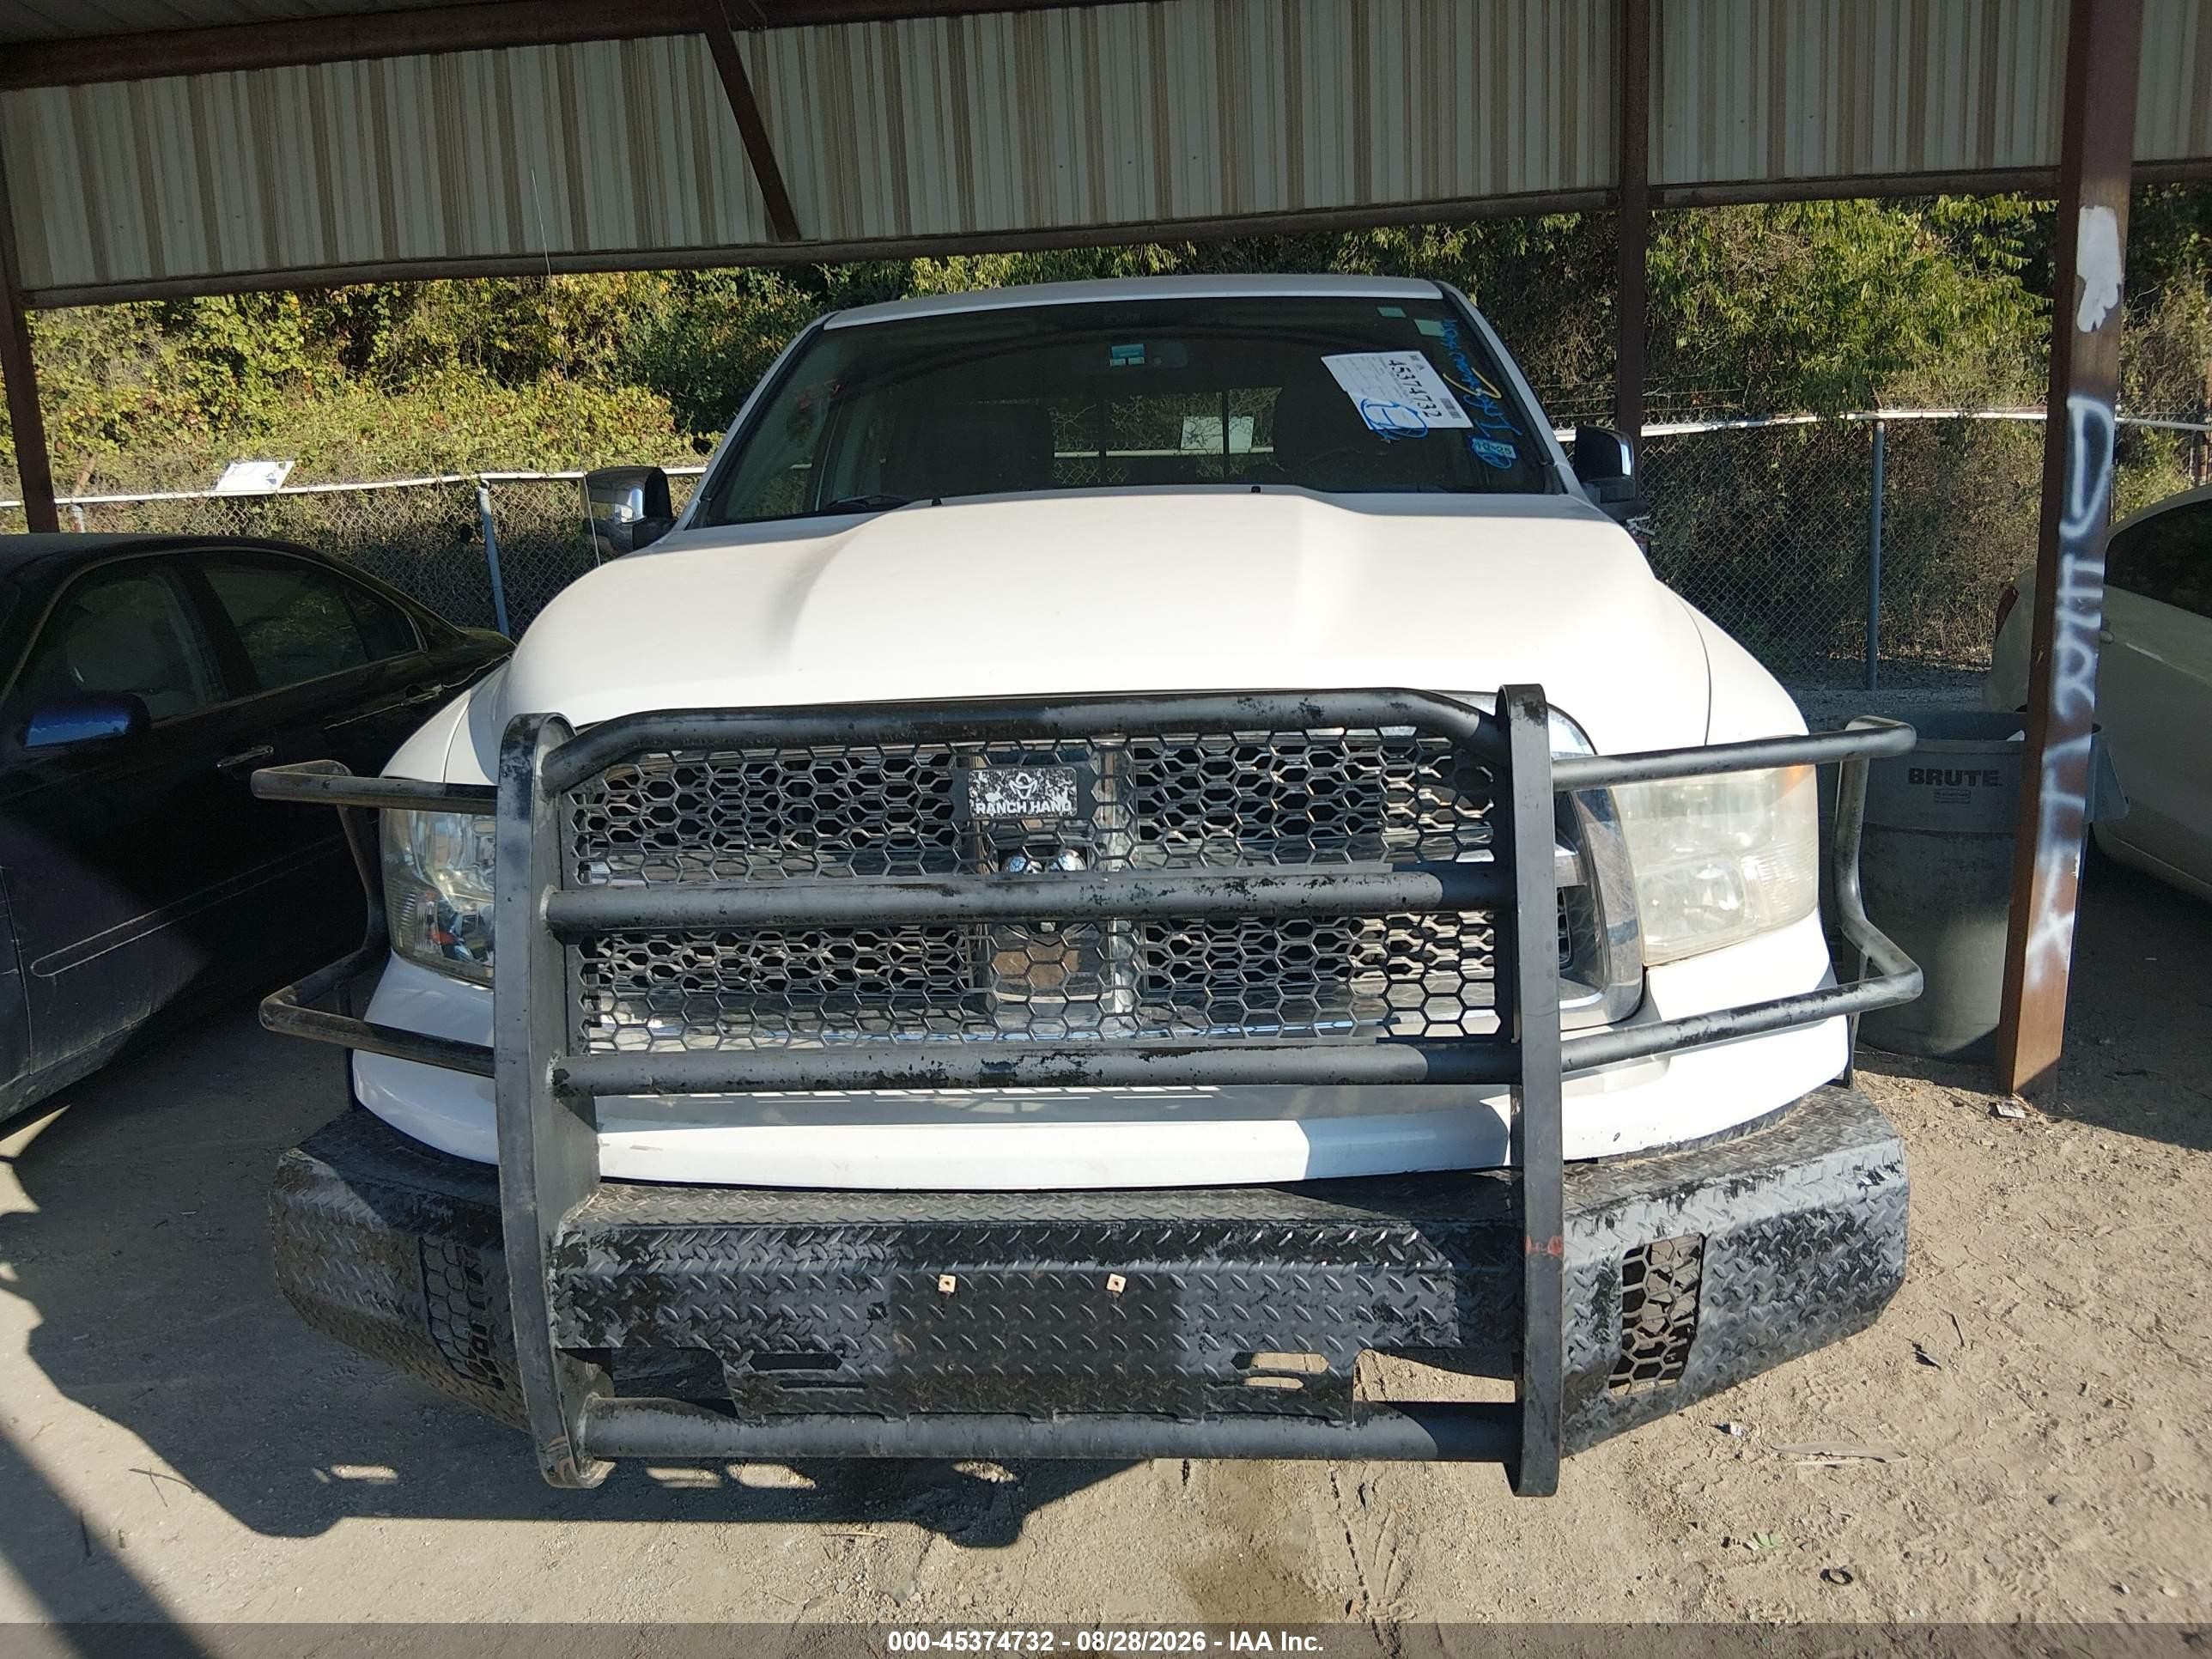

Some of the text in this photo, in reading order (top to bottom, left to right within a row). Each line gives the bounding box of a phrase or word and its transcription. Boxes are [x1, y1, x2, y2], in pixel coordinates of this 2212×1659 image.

[1389, 359, 1443, 418] 45374732
[1908, 767, 1999, 787] BRUTE
[975, 800, 1072, 815] RANCH HAND
